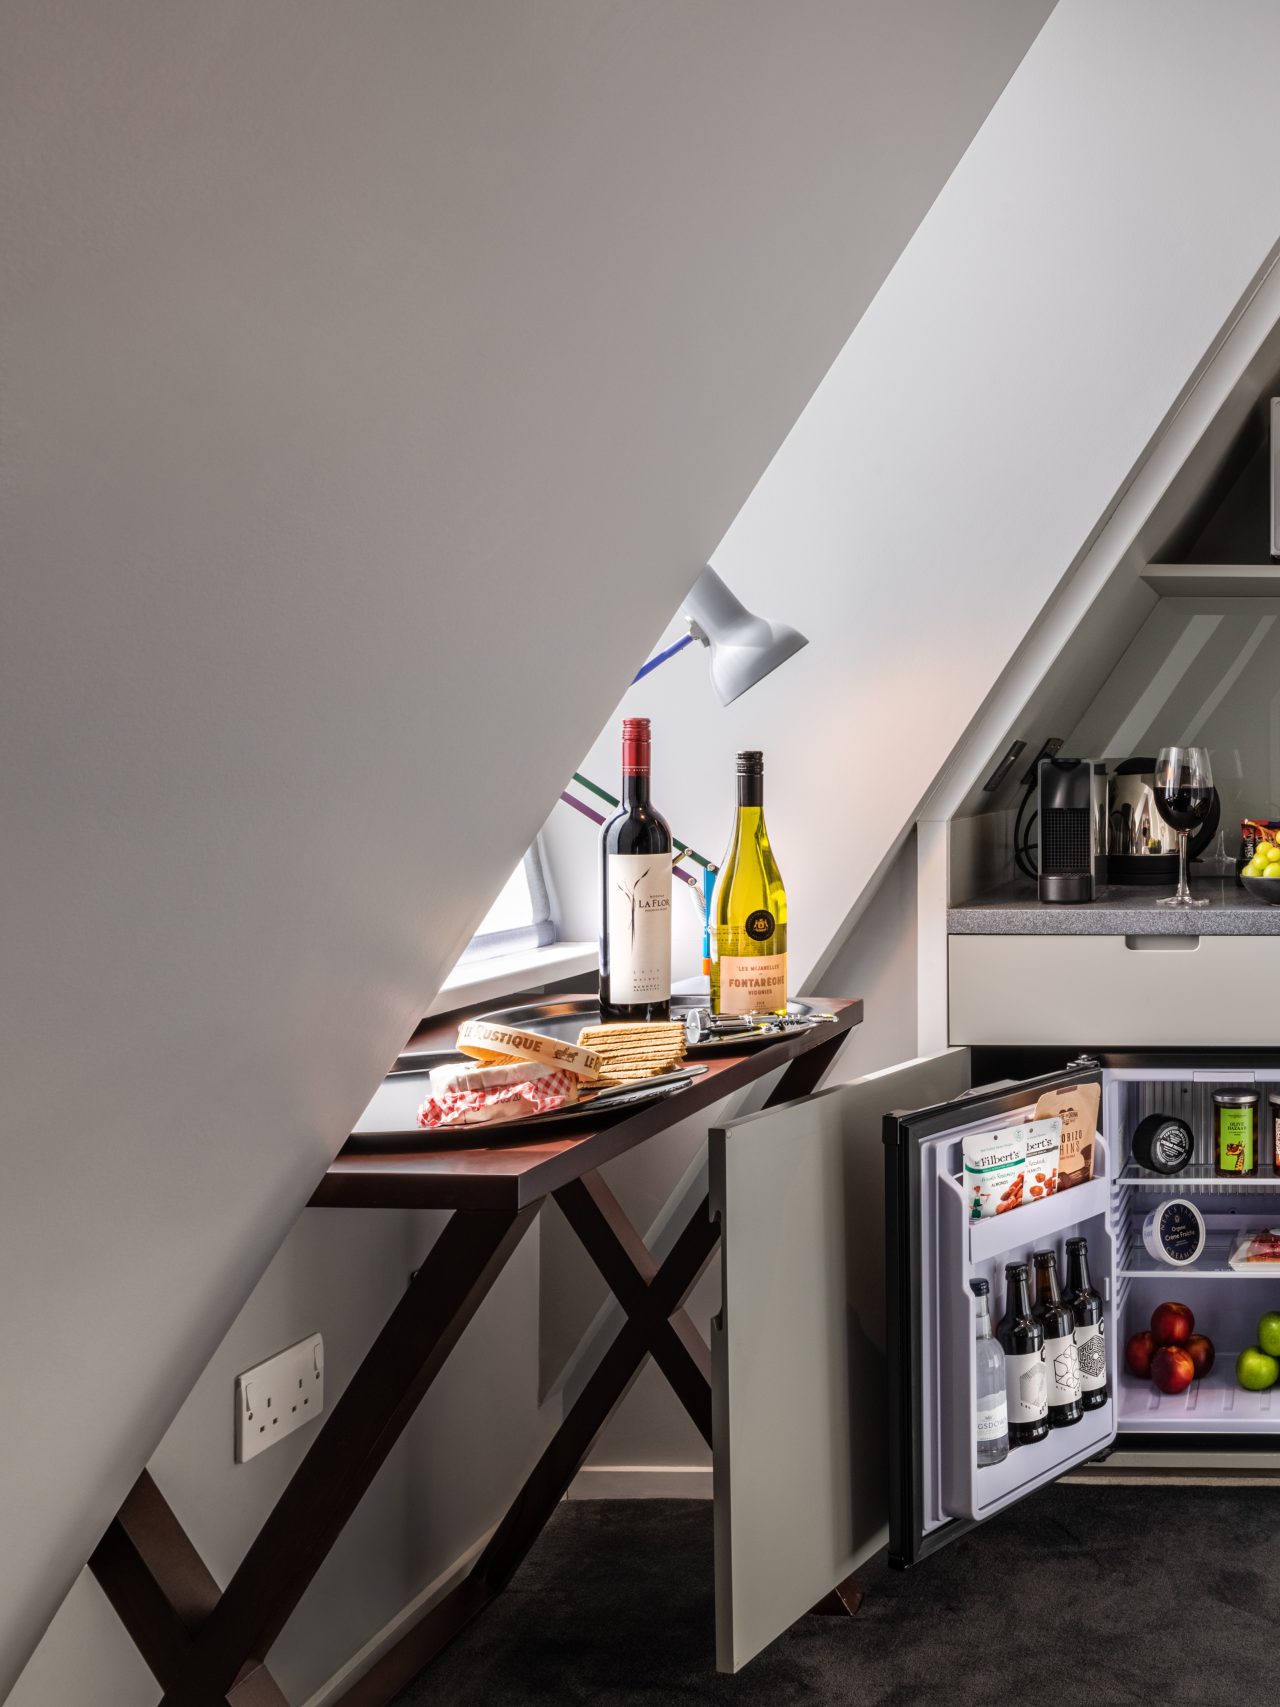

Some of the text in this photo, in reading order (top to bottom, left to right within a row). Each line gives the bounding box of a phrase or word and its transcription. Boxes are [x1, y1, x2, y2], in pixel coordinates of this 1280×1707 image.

[638, 899, 651, 908] LA
[583, 1055, 593, 1069] LE
[1061, 1129, 1083, 1144] ORIZO
[1026, 1138, 1053, 1151] bert's
[1059, 1141, 1080, 1156] HINS
